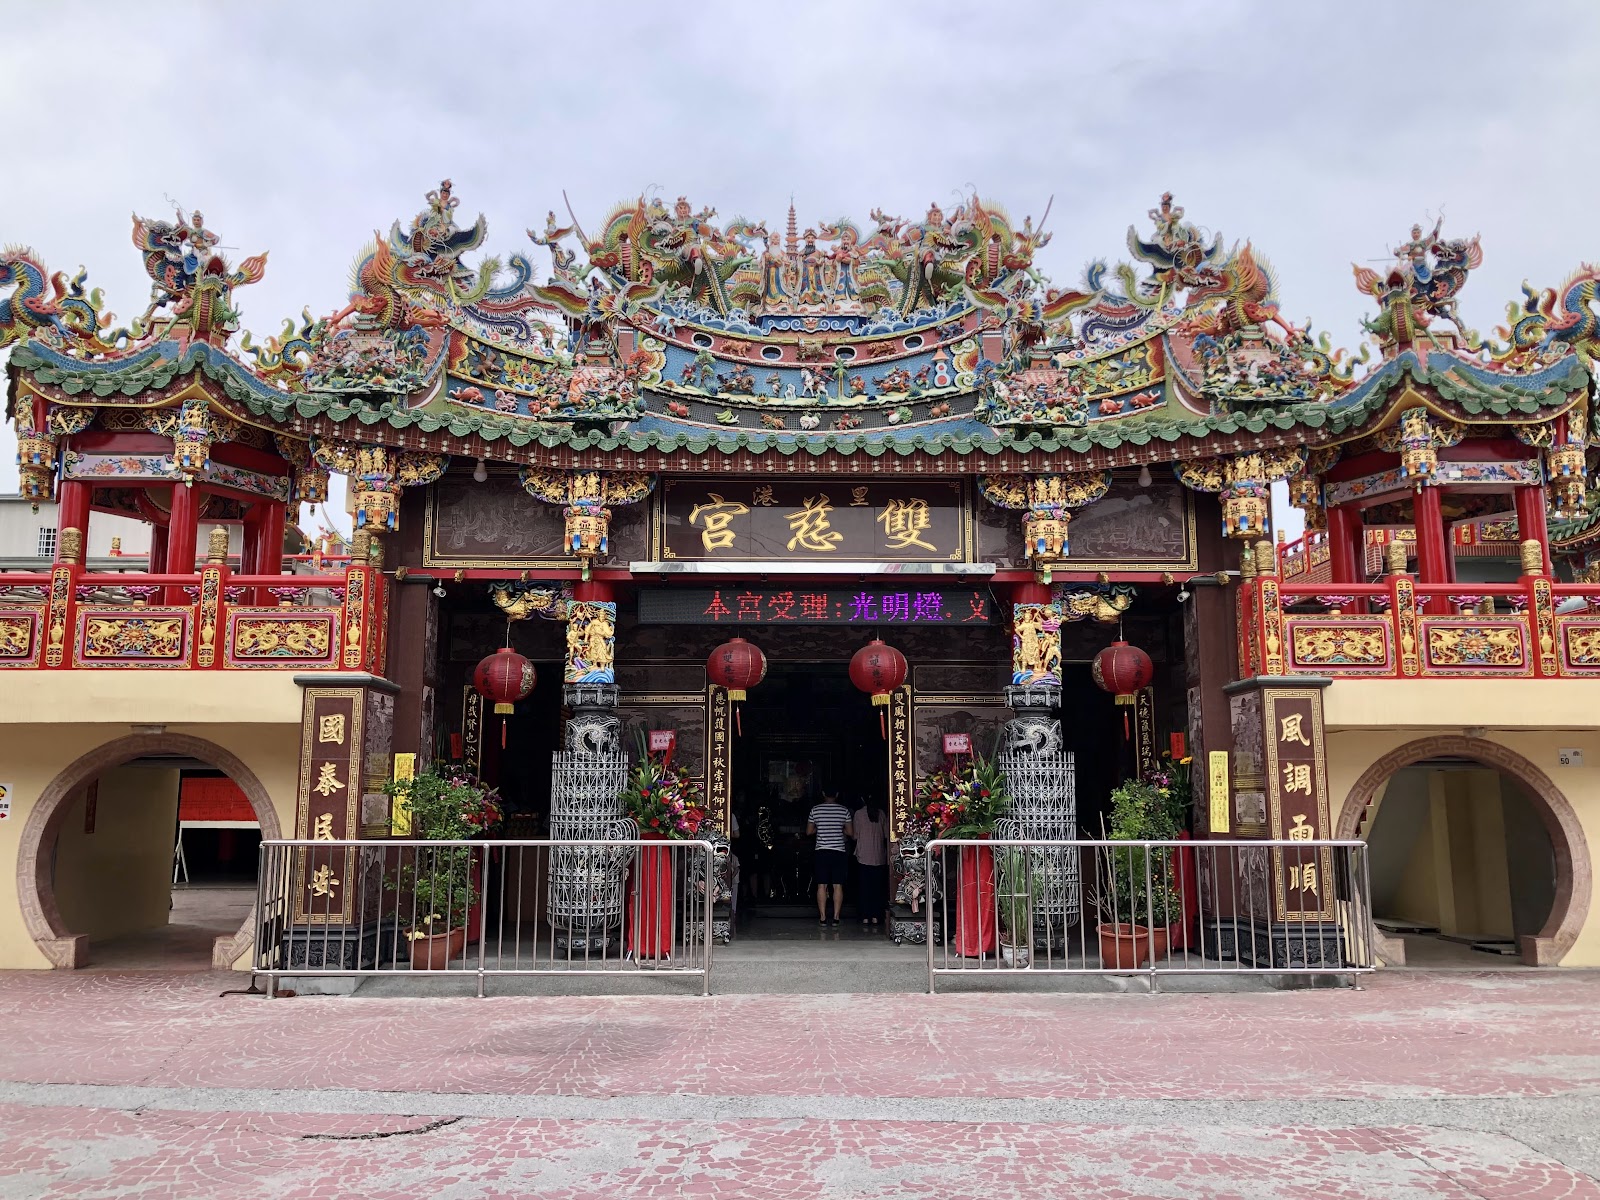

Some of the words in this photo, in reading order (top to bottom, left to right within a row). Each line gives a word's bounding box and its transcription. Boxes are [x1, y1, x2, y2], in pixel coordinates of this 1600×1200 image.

[688, 493, 938, 553] 雙慈宮
[308, 713, 346, 899] 國泰民安
[1280, 712, 1319, 897] 風調雨順
[1560, 757, 1570, 765] 50
